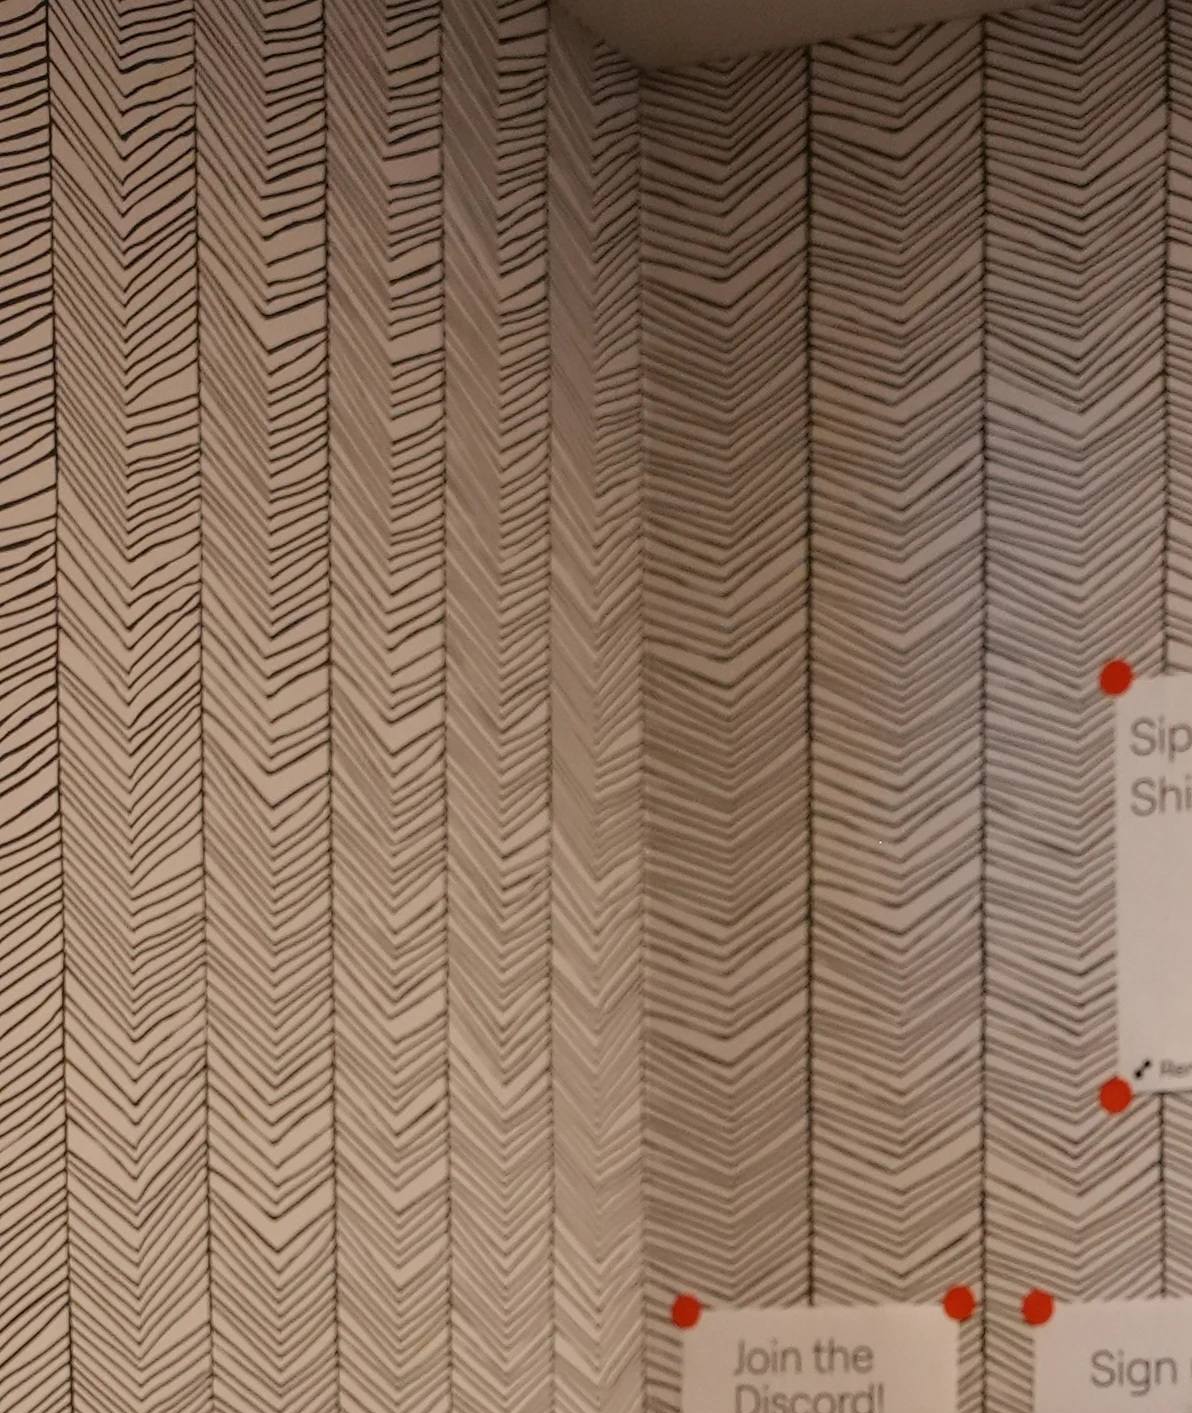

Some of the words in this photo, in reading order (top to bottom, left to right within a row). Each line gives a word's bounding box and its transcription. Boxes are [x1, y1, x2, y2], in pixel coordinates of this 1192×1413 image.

[734, 1337, 802, 1375] Join
[813, 1336, 874, 1374] the
[1091, 1349, 1178, 1397] Sign
